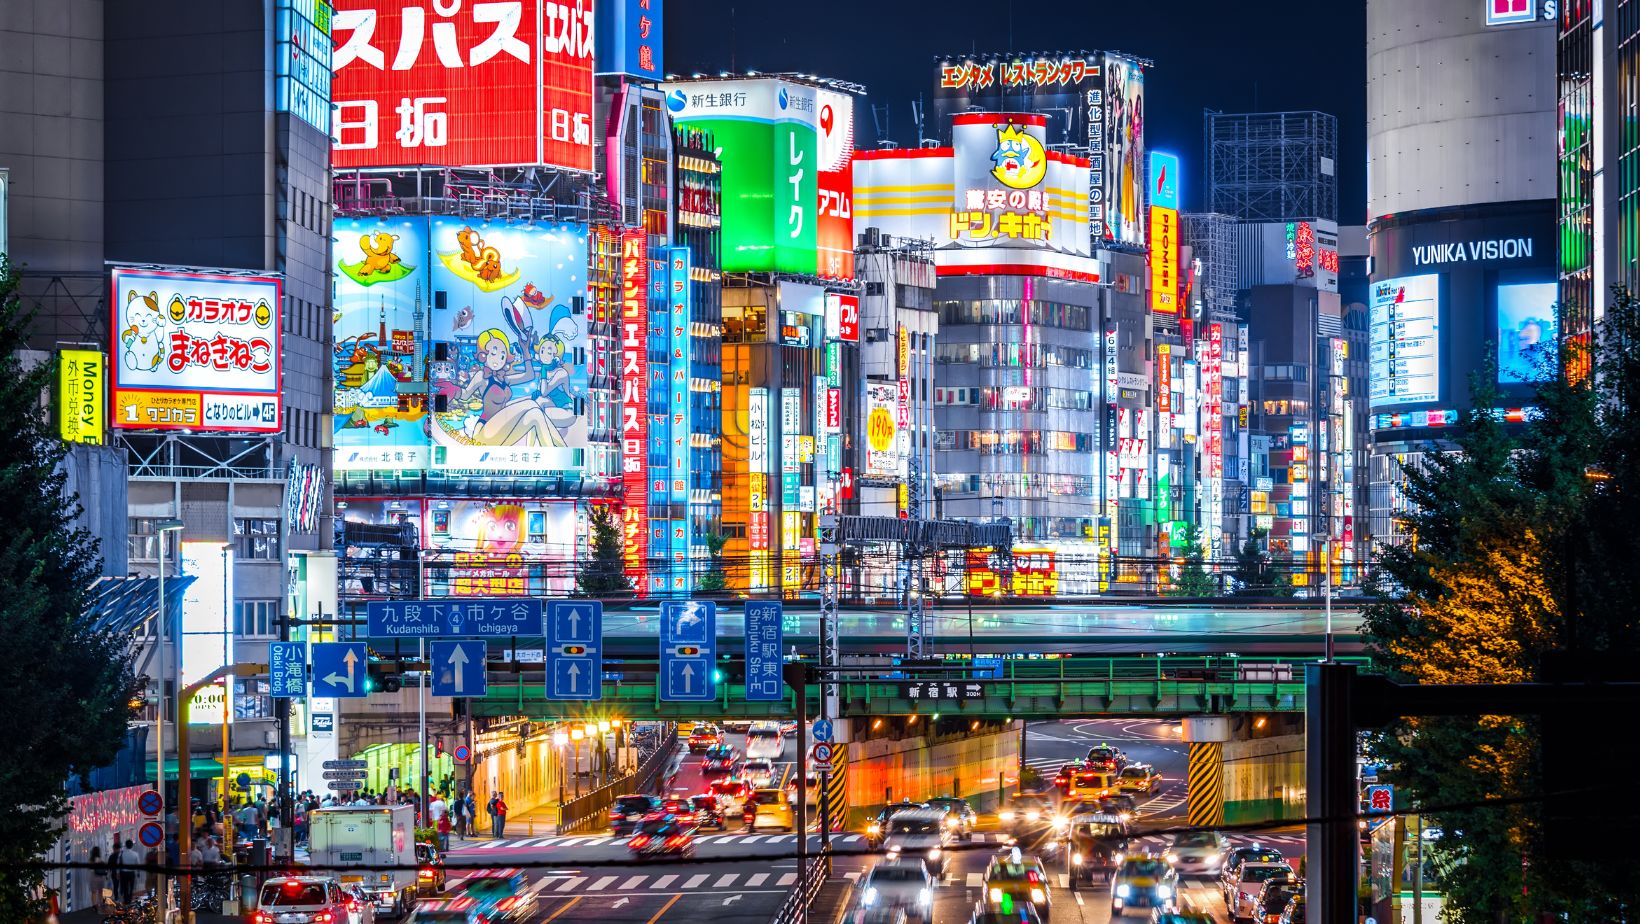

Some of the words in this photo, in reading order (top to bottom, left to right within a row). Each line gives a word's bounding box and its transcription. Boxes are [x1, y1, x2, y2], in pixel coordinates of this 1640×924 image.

[941, 64, 995, 88] エンタメ
[1000, 59, 1101, 88] レストランタワー
[691, 92, 747, 108] 新生銀行
[789, 94, 814, 113] 新生銀行
[332, 97, 447, 150] 日拓
[551, 108, 590, 145] 日拓
[1088, 89, 1103, 236] 進化型居酒屋の聖地
[788, 131, 804, 239] レイク
[818, 188, 851, 219] アコム
[1161, 213, 1172, 287] PROMISE
[1412, 243, 1467, 265] YUNIKA
[1470, 237, 1533, 260] VISION
[187, 300, 253, 324] カラオケ
[168, 328, 273, 374] まねきねこ
[82, 361, 97, 427] Money
[145, 405, 197, 424] ワンカラ
[204, 402, 252, 421] となりのビル
[262, 404, 276, 422] 4F
[829, 397, 838, 427] アイフル
[750, 402, 761, 461] 小松ビル
[381, 451, 418, 463] 北電子
[509, 451, 542, 463] 北電子
[455, 577, 524, 595] 超大型店
[381, 603, 444, 623] 九段下
[452, 614, 460, 625] 4
[386, 625, 440, 634] Kudanshita
[478, 624, 518, 634] Ichigaya
[750, 608, 761, 653] Shinjuku
[272, 645, 283, 670] Otaki
[761, 607, 778, 695] 新宿駅東口
[272, 672, 283, 694] Brdg.
[284, 645, 303, 695] 小滝橋
[909, 686, 958, 698] 新宿駅
[1371, 789, 1392, 809] 祭
